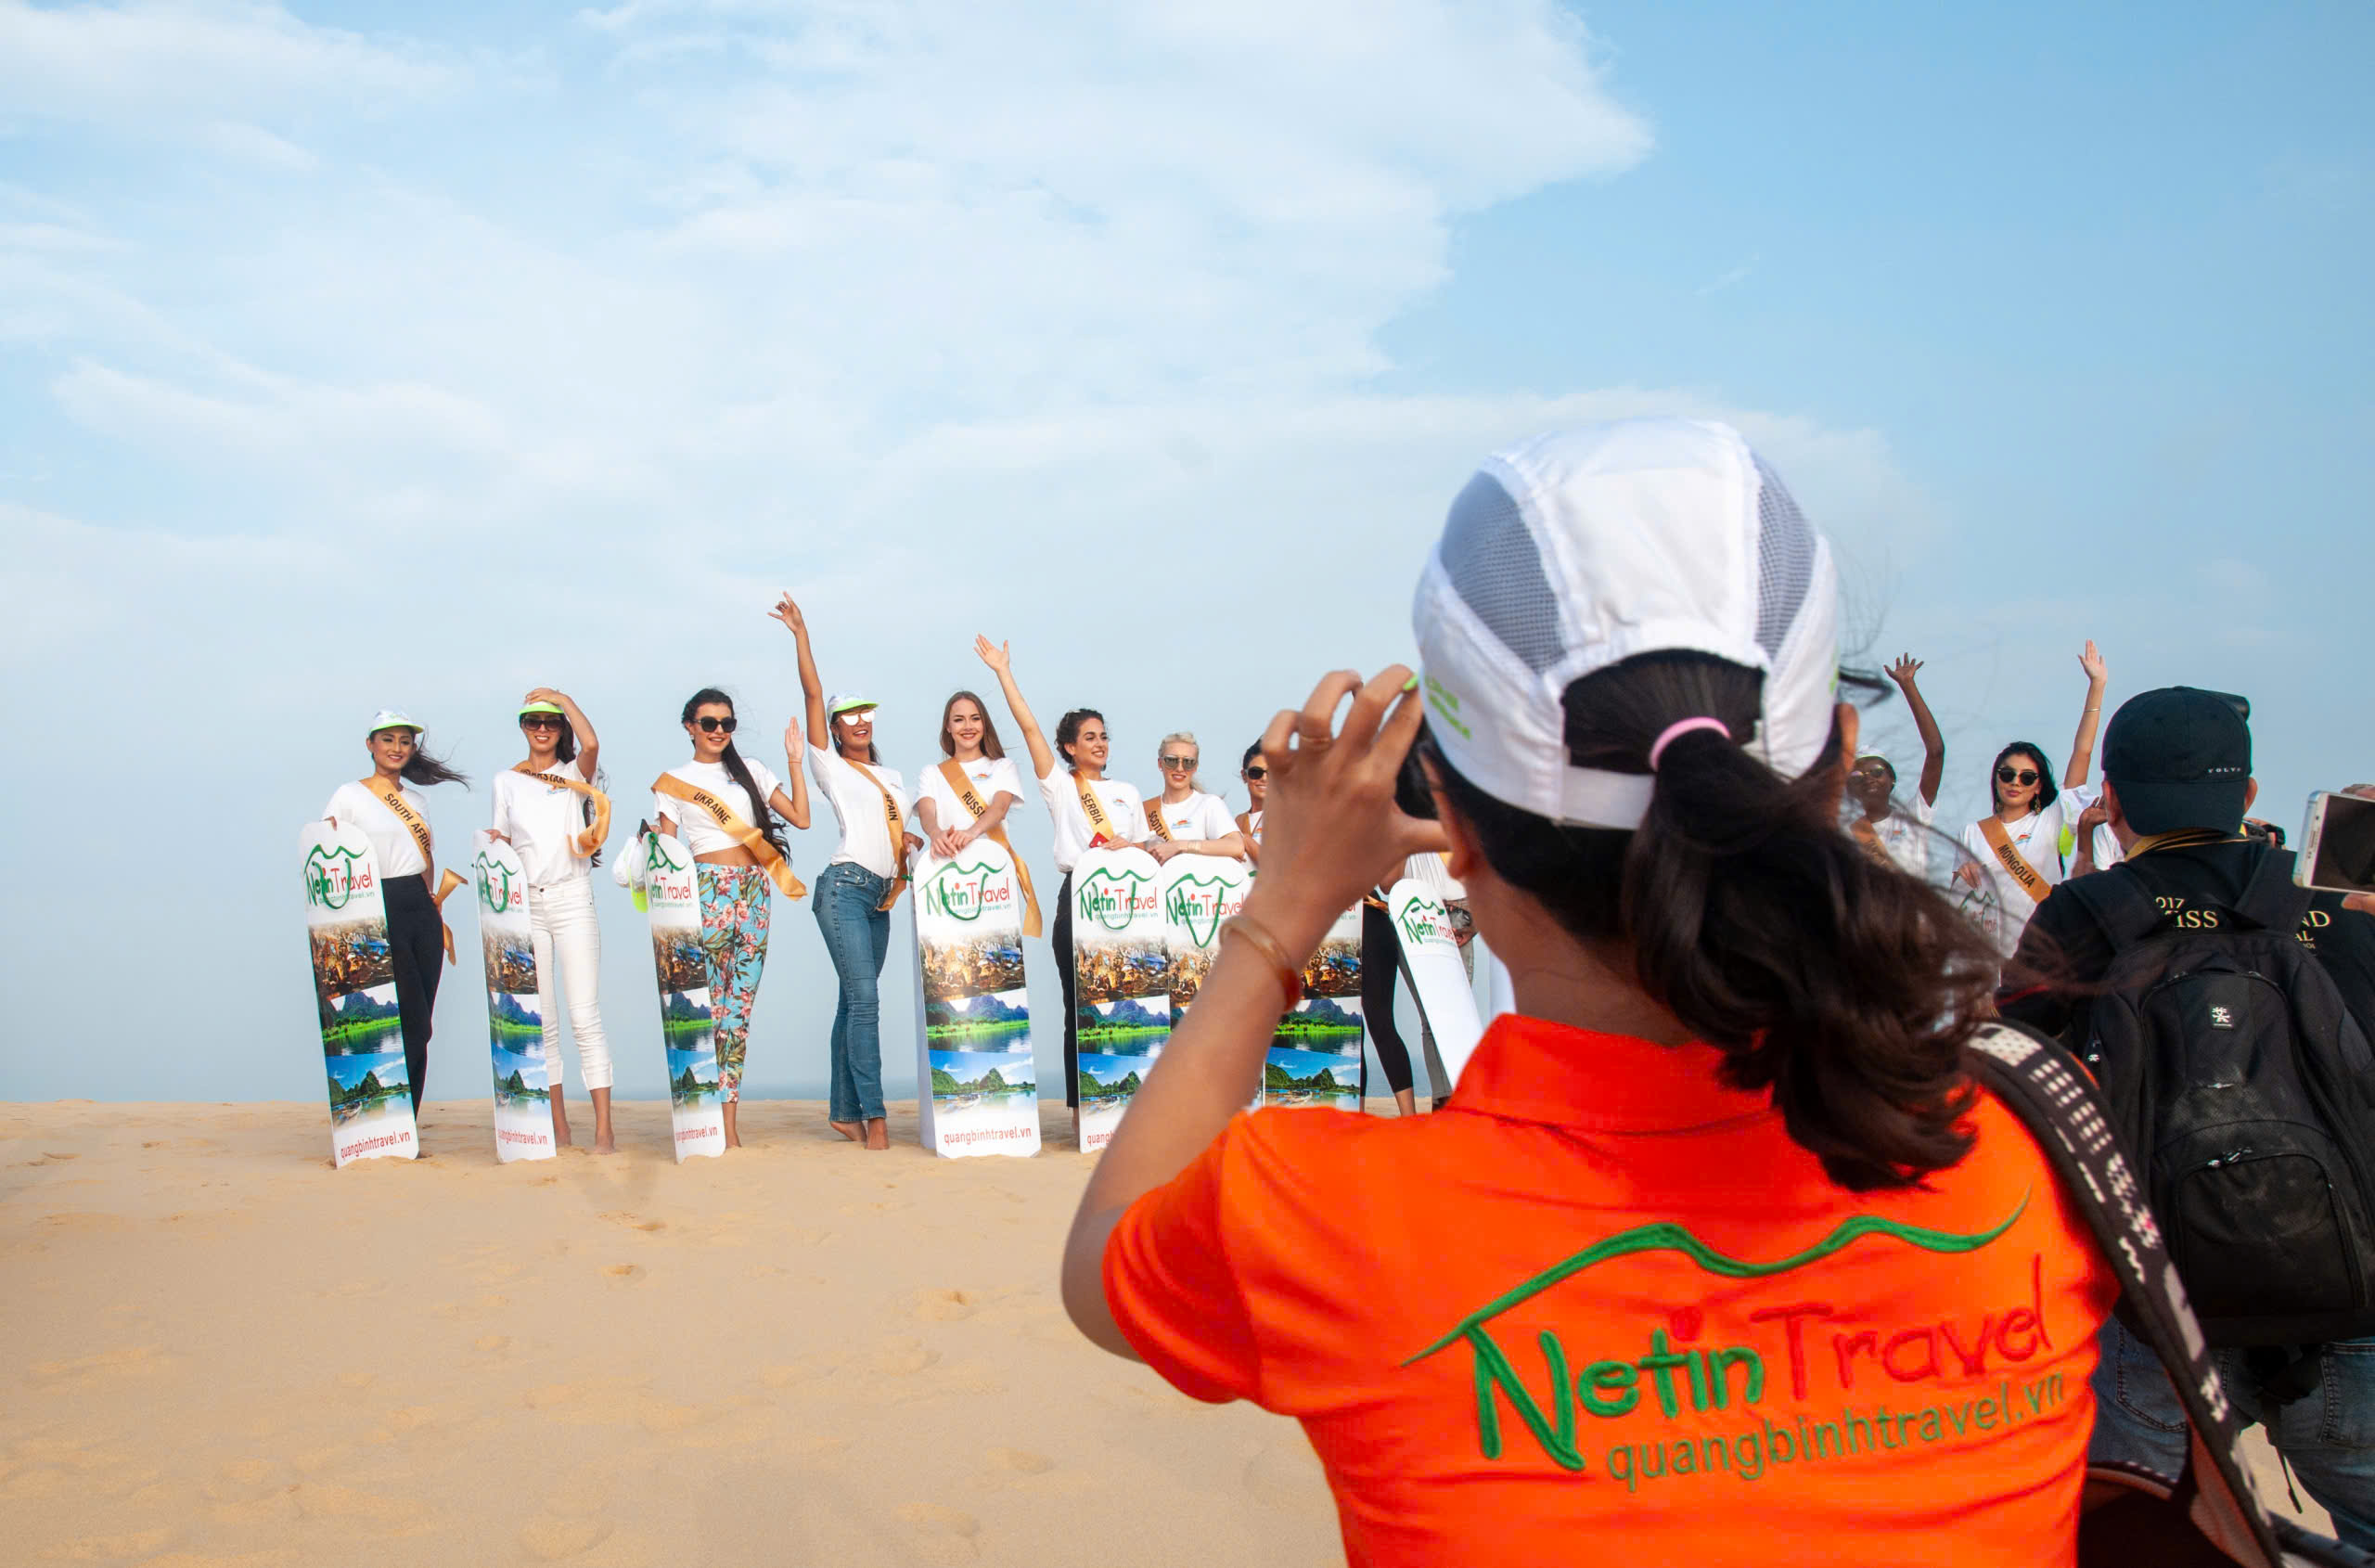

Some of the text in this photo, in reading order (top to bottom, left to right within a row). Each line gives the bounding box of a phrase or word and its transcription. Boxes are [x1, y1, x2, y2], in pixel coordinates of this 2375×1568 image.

[384, 793, 414, 821] SOUTH
[693, 791, 731, 825] UKRAINE
[884, 793, 899, 821] SPAIN
[962, 790, 986, 817] RUSSI
[1081, 793, 1104, 825] SERBIA
[1997, 844, 2036, 888] MONGOLIA
[491, 876, 522, 906] Trvel
[660, 875, 692, 900] Travel
[966, 876, 1010, 906] Travel
[1114, 886, 1159, 912] Travel
[340, 1131, 411, 1161] quangbinhtravel.vn
[944, 1125, 1032, 1147] quangbinhtravel.vn
[1466, 1253, 2054, 1472] Netin Travel
[1607, 1371, 2065, 1493] quangbinhtravel.vn
